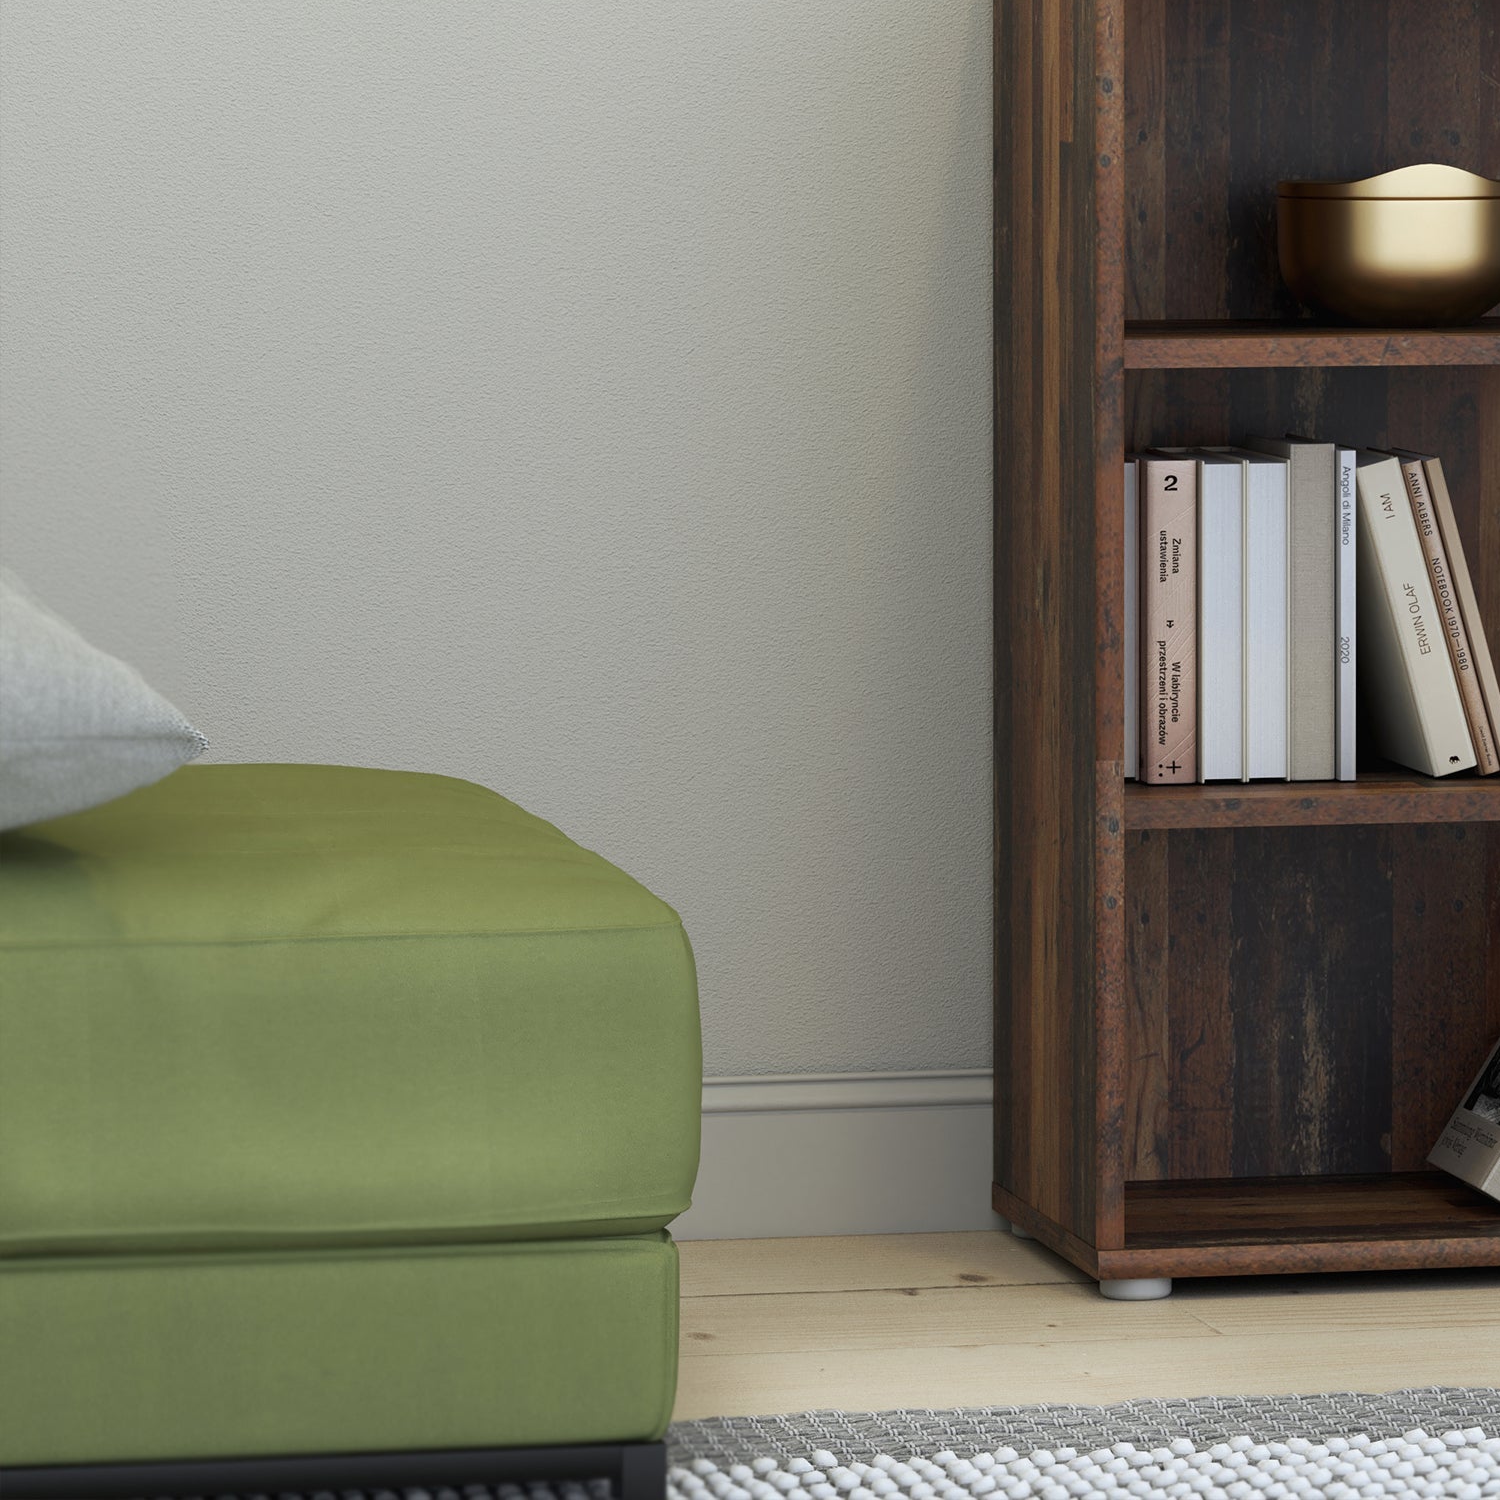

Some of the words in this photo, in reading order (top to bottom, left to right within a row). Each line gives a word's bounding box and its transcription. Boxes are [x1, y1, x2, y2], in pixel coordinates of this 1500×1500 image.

[1164, 475, 1178, 491] 2
[1341, 466, 1352, 498] Angoli
[1342, 501, 1351, 509] di
[1380, 493, 1393, 512] AM
[1342, 512, 1351, 546] Milano
[1408, 472, 1423, 498] ANNI
[1416, 501, 1433, 537] ALBERS
[1431, 557, 1453, 614] NOTEBOOK
[1160, 530, 1169, 582] ustawienia
[1172, 538, 1181, 574] Zmiana
[1403, 583, 1419, 614] OLAF
[1340, 636, 1350, 664] 2020
[1413, 616, 1431, 656] ERWIN
[1157, 640, 1167, 696] przestrzeni
[1172, 661, 1181, 672] W
[1169, 674, 1181, 723] labiryncie
[1158, 703, 1168, 746] obrazów
